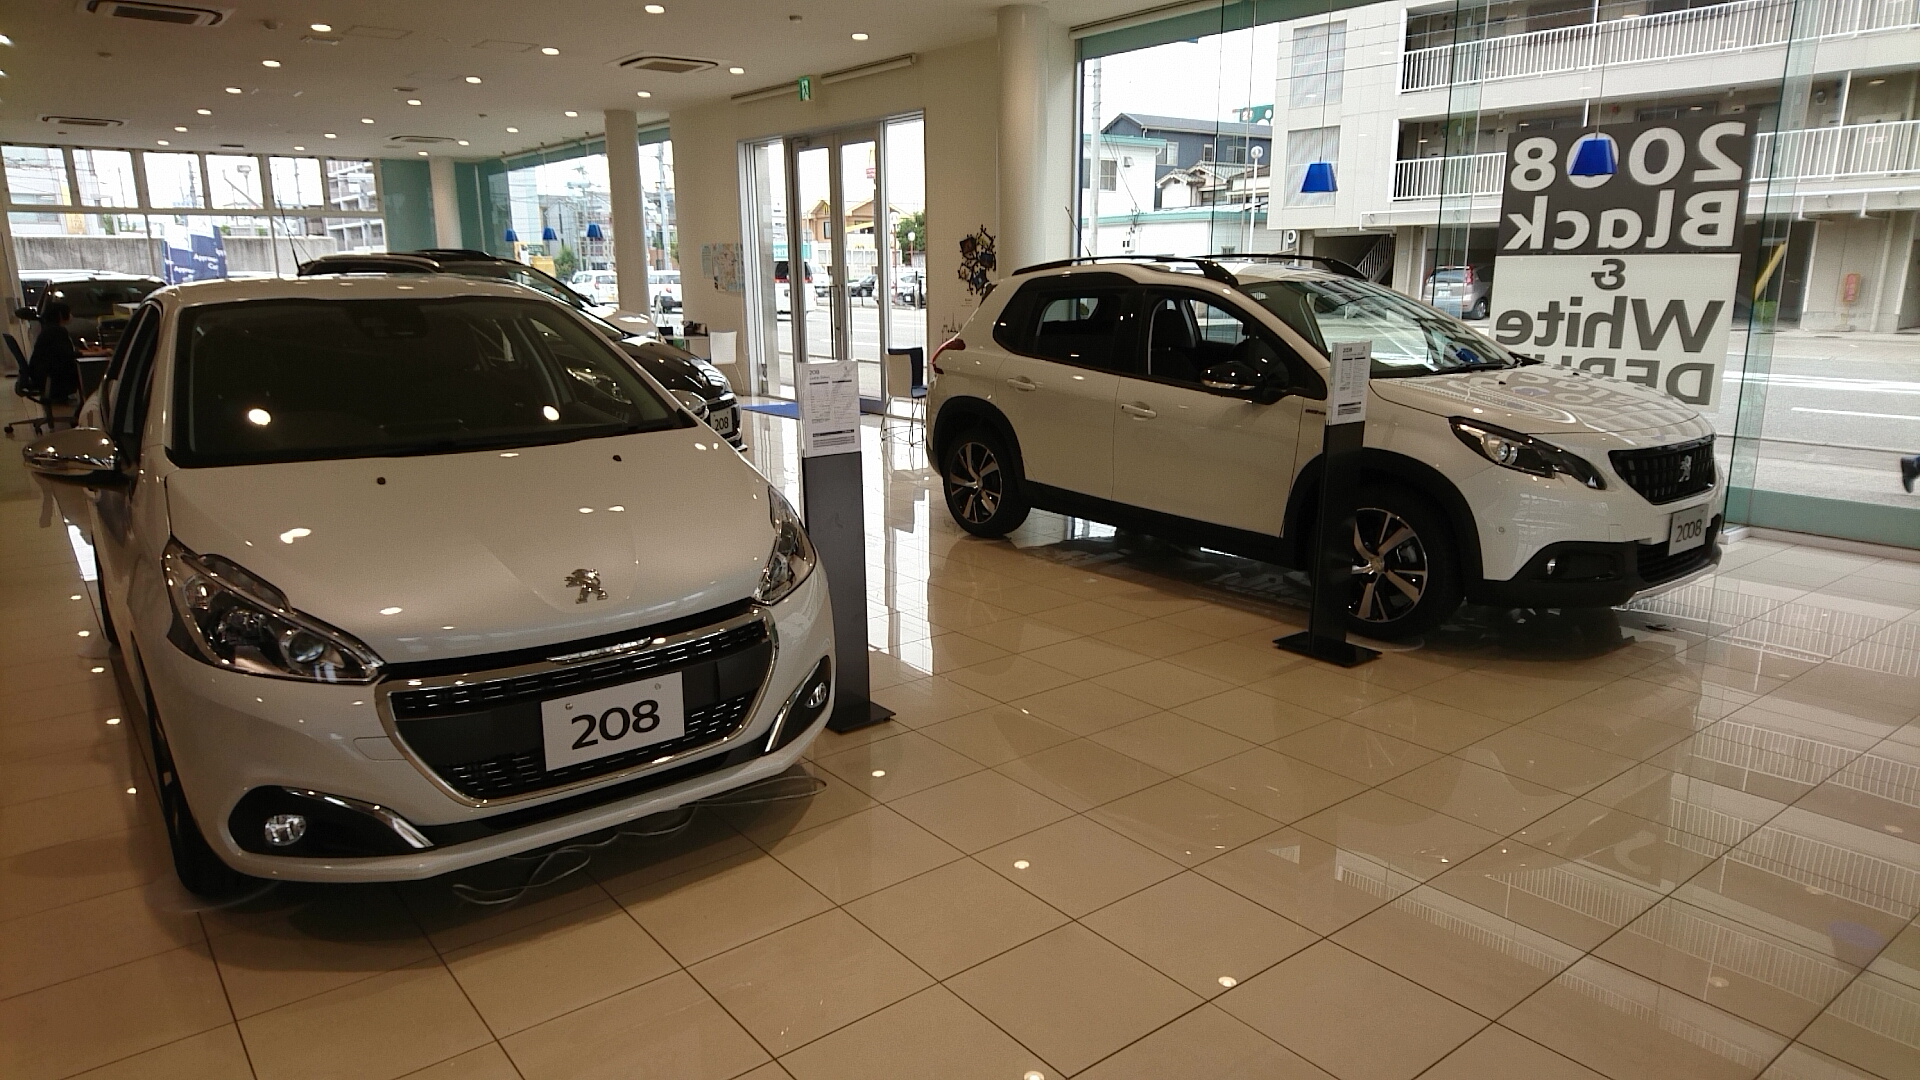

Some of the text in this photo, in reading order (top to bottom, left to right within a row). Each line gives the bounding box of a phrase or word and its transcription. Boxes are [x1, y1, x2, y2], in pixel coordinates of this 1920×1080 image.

[715, 416, 729, 431] 208
[1676, 519, 1702, 543] 2008
[571, 700, 660, 750] 208
